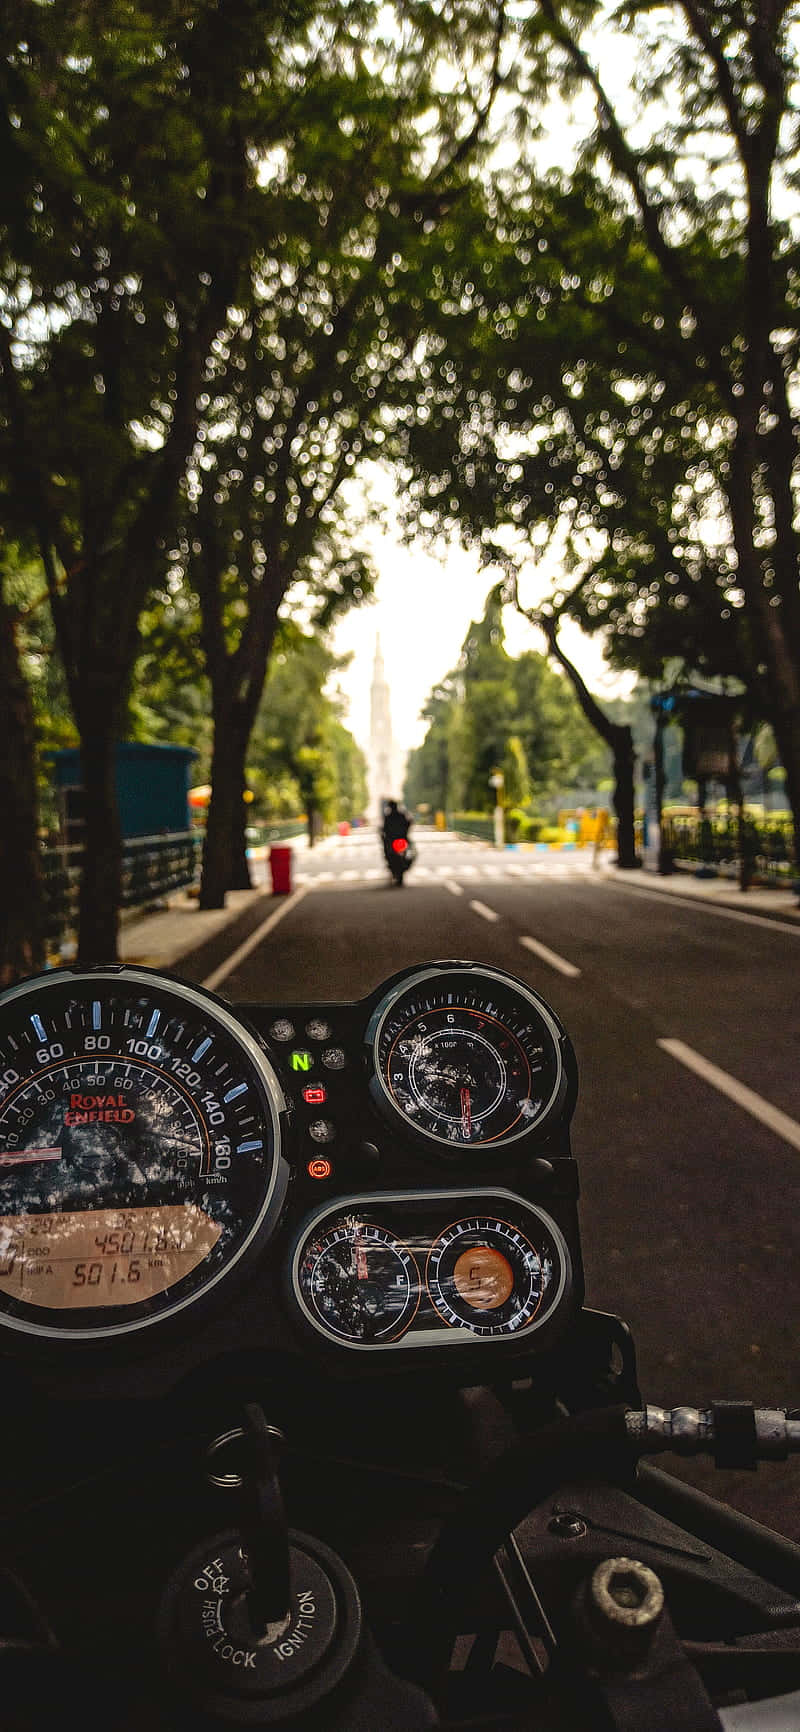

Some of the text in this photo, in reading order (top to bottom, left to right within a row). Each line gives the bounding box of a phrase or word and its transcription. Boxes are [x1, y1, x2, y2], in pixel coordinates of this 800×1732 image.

[417, 1022, 427, 1032] 5
[446, 1014, 455, 1024] 6
[84, 1035, 110, 1050] 80
[126, 1038, 162, 1060] 100
[35, 1043, 64, 1064] 60
[291, 1053, 310, 1071] N
[87, 1075, 106, 1087] 50
[171, 1057, 201, 1087] 120
[393, 1073, 404, 1081] 3
[63, 1078, 81, 1091] 40
[114, 1076, 133, 1090] 60
[37, 1089, 56, 1106] 30
[70, 1094, 127, 1110] ROYAL
[18, 1107, 34, 1126] 20
[201, 1091, 225, 1125] 140
[64, 1108, 136, 1127] ENFIELD
[6, 1132, 19, 1149] 10
[215, 1135, 231, 1169] 160
[206, 1175, 228, 1185] km/h
[72, 1260, 141, 1287] 501.6
[396, 1275, 405, 1286] F
[194, 1558, 225, 1591] OFF
[202, 1600, 217, 1638] PUSH
[273, 1590, 316, 1661] IGNITION
[213, 1638, 257, 1668] LOCK
